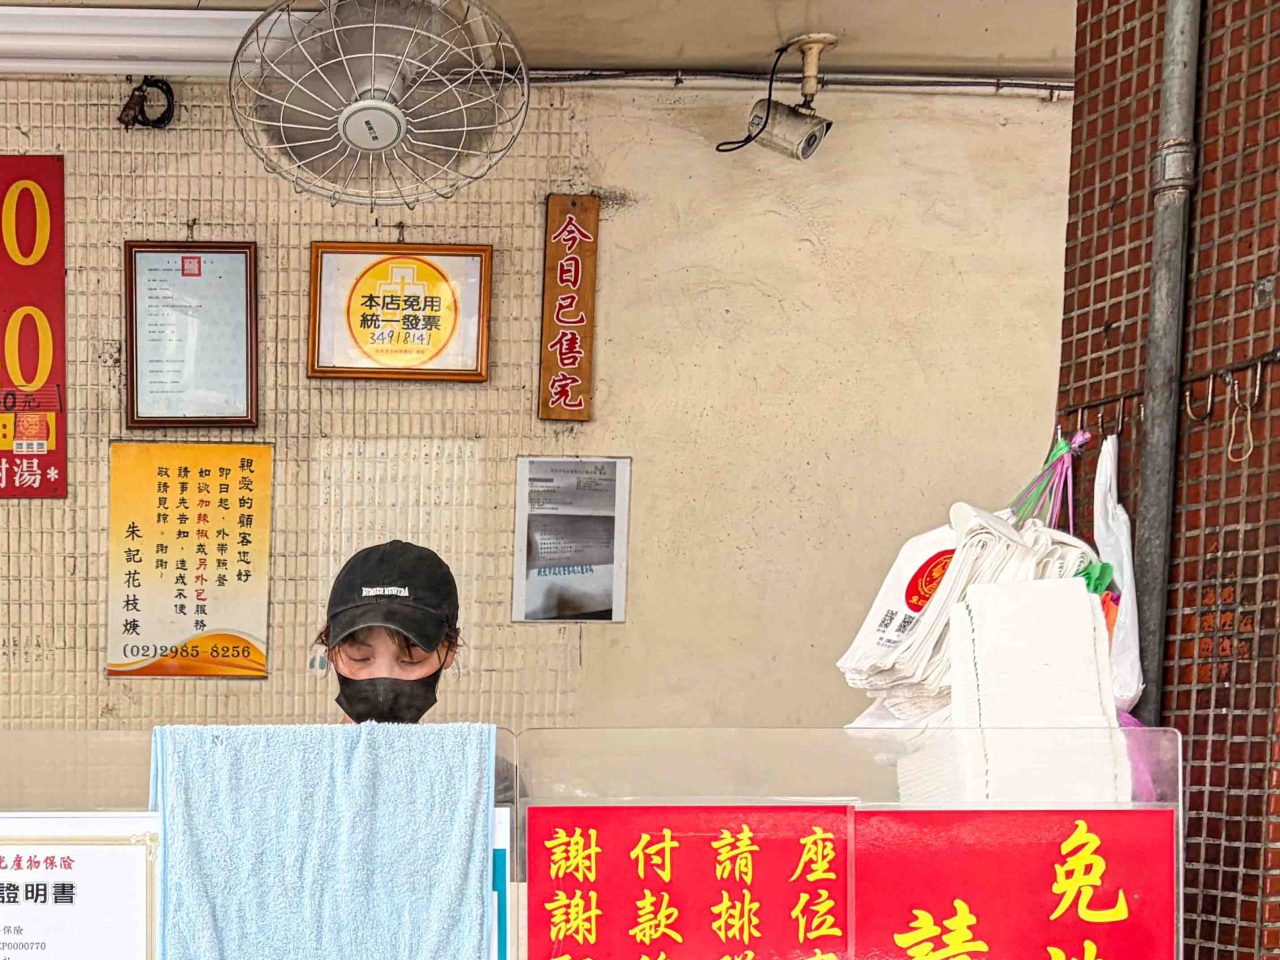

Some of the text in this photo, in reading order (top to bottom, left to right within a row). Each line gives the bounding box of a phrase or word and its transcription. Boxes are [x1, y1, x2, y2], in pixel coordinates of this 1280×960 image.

[360, 294, 442, 312] 本店免用
[549, 213, 594, 410] 今日已售完
[360, 313, 442, 331] 統一發票
